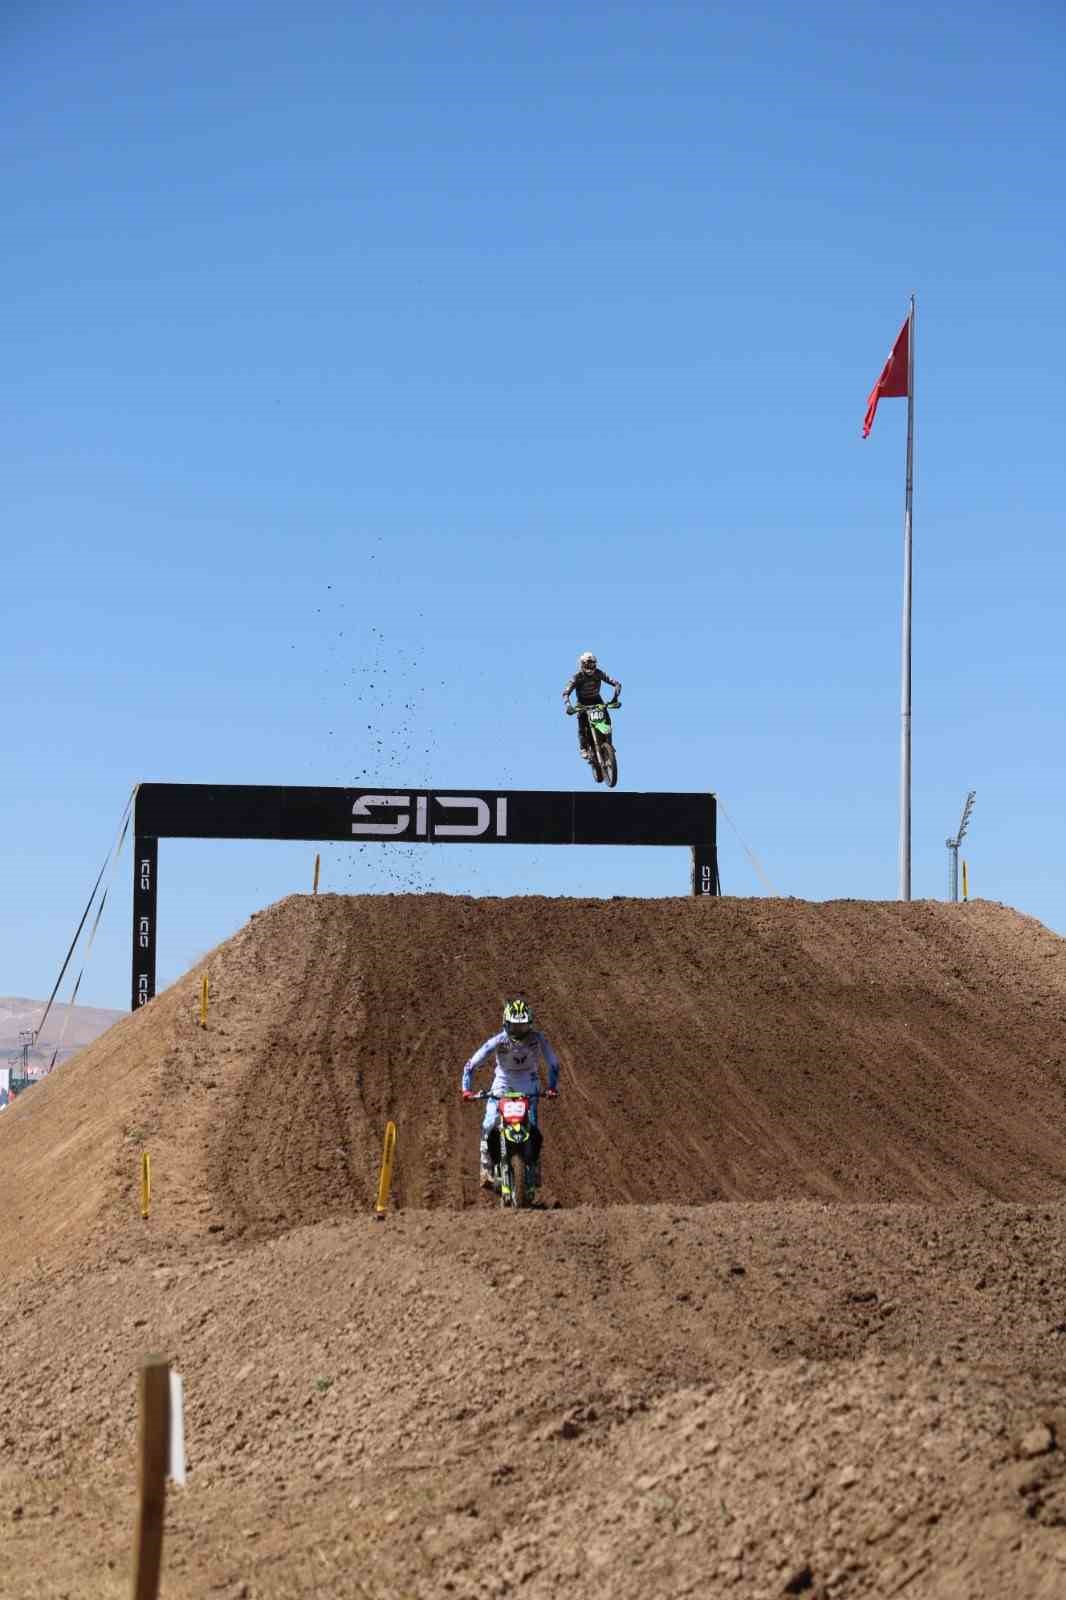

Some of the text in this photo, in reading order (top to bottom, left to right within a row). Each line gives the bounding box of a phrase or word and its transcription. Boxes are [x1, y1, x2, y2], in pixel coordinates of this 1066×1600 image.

[352, 795, 507, 836] SIDI
[140, 859, 150, 890] SIDI
[702, 865, 710, 896] SIDI
[139, 917, 149, 948] SIDI
